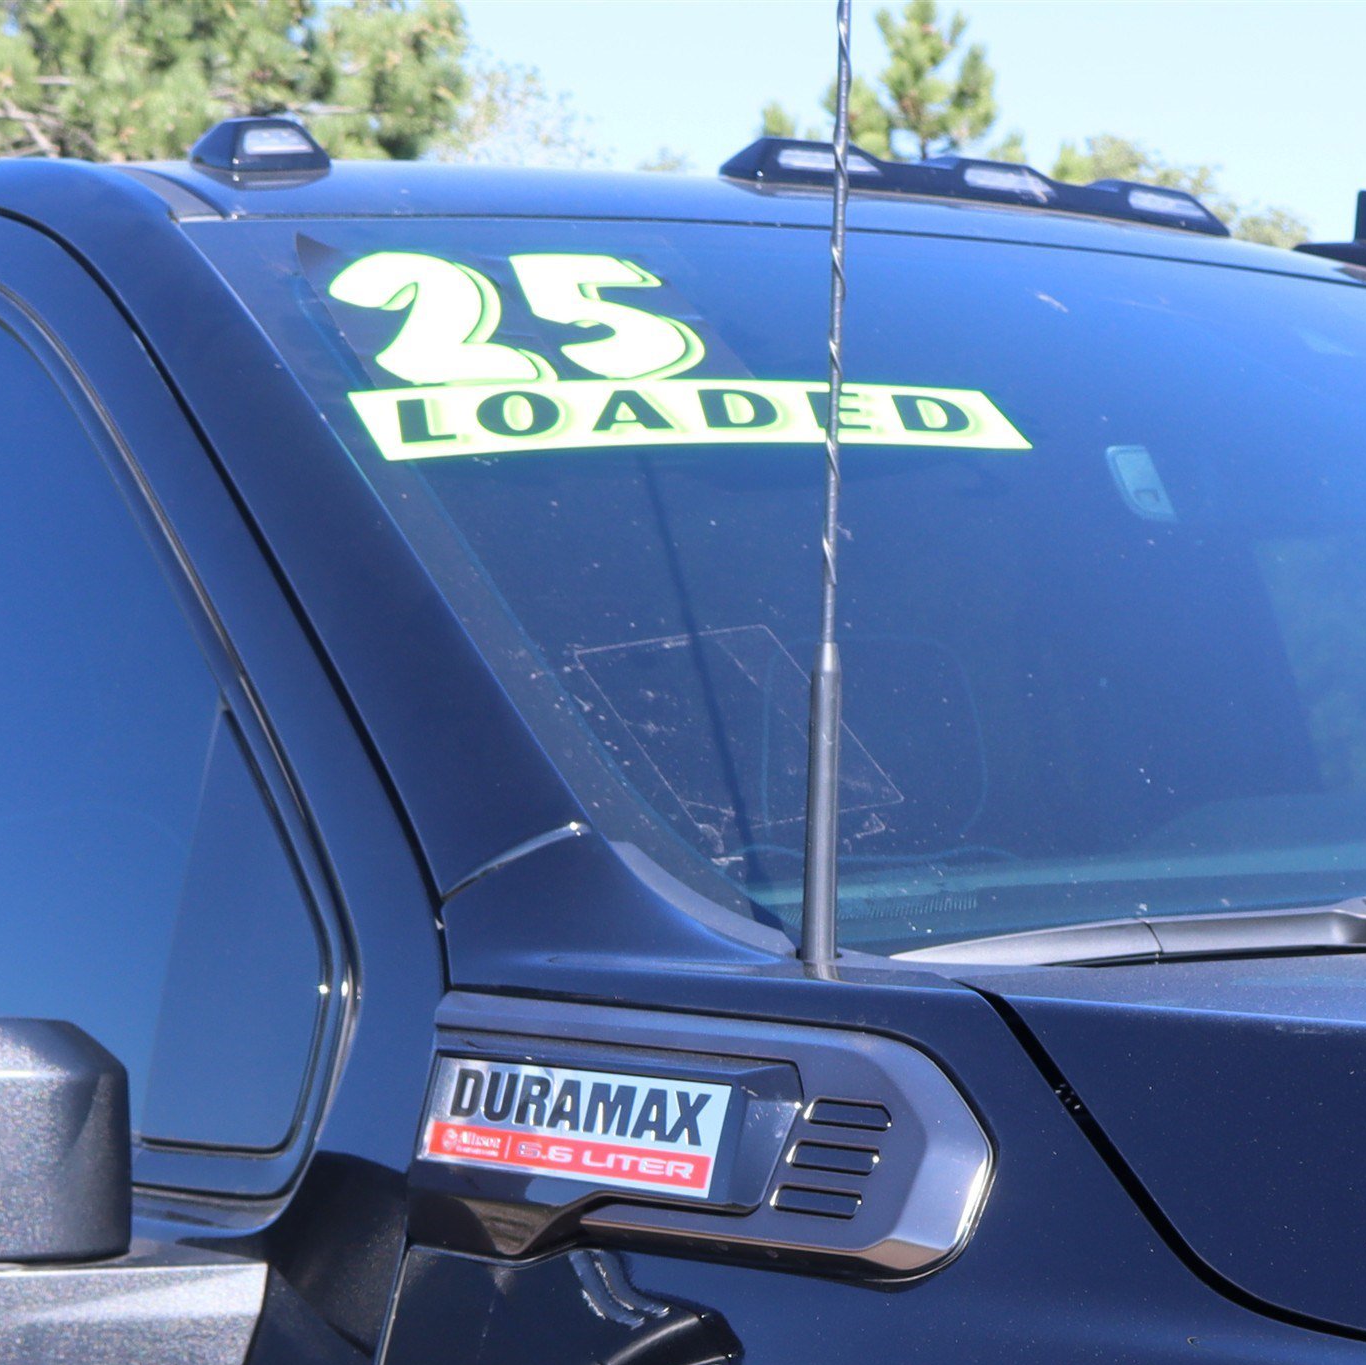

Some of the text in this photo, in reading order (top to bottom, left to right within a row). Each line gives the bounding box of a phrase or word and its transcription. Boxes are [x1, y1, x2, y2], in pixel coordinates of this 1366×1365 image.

[328, 250, 706, 384] 25
[395, 387, 972, 445] LOADED
[449, 1067, 712, 1147] DURAMAX
[582, 1150, 695, 1180] LITER
